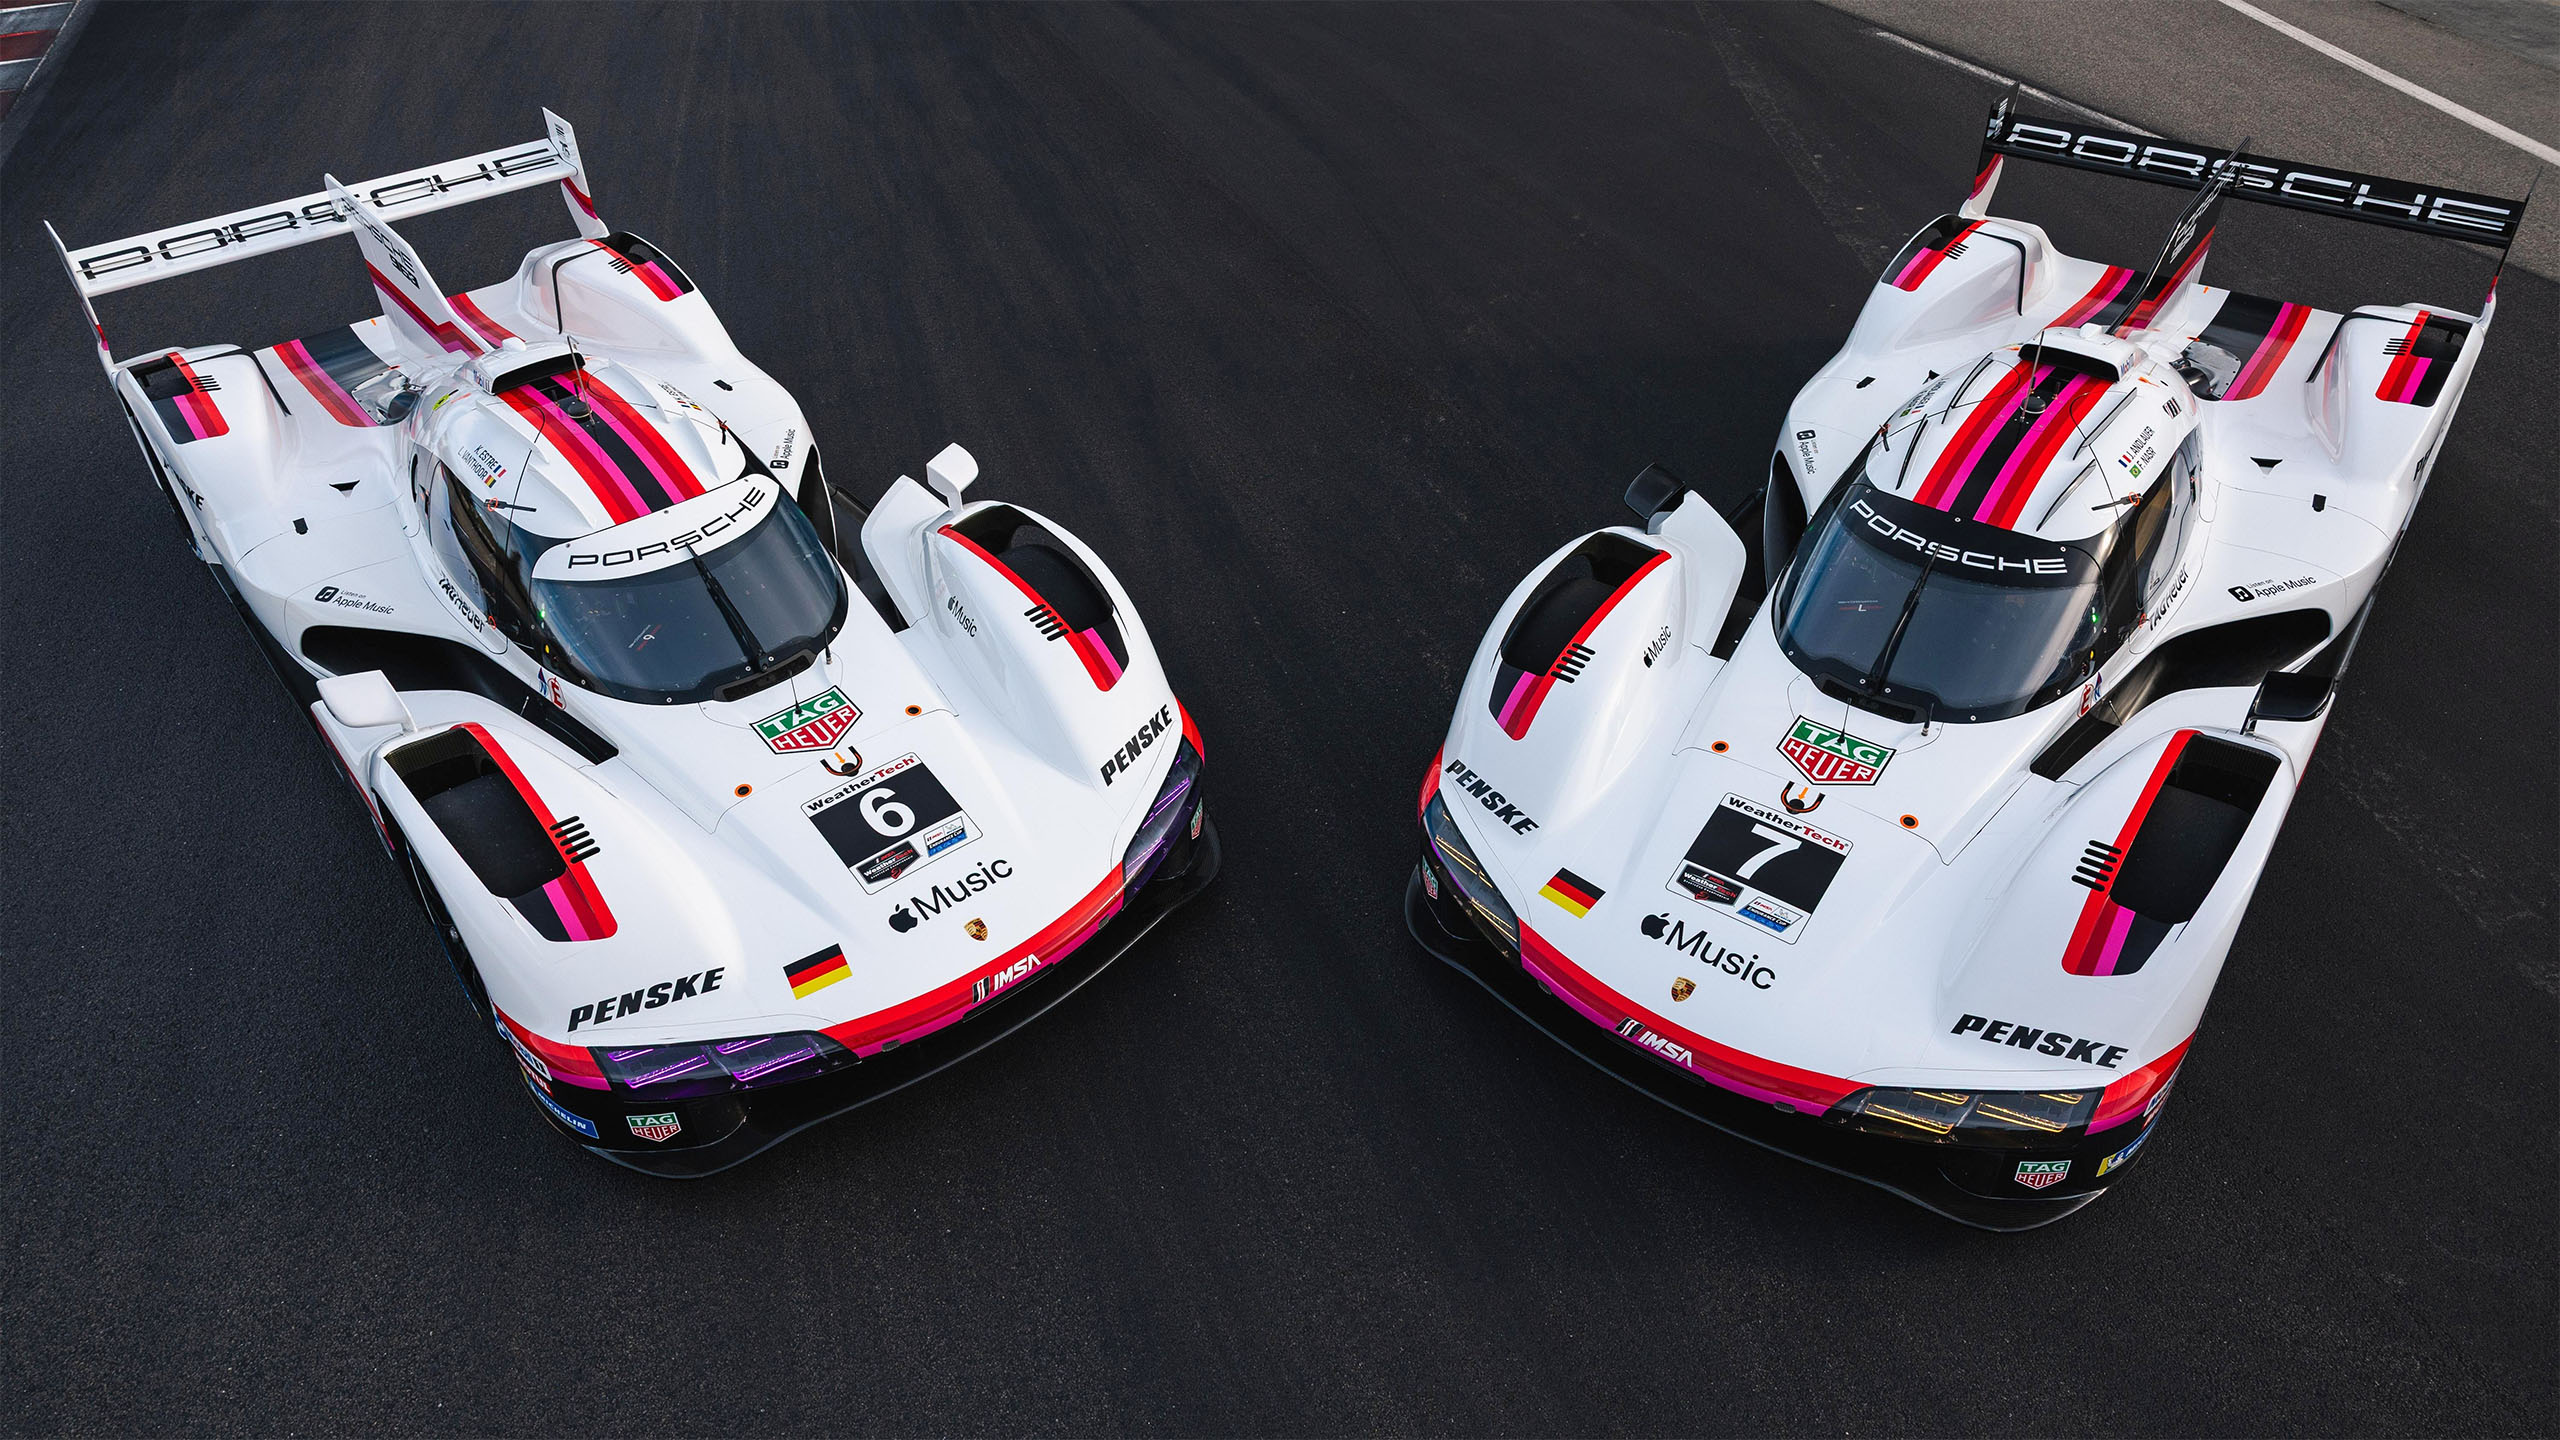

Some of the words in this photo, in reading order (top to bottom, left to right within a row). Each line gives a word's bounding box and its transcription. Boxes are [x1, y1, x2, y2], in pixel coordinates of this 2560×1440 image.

[2006, 122, 2511, 231] PORSCHE
[78, 147, 560, 281] PORSCHE
[460, 450, 489, 481] VANTHOOR
[478, 450, 499, 471] ESTRE
[1803, 457, 1817, 475] Music
[2142, 446, 2157, 467] NASR
[567, 486, 766, 569] PORSCHE
[1849, 499, 2068, 574] PORSCHE
[332, 596, 363, 608] Apple
[362, 601, 395, 615] Music
[2254, 584, 2286, 598] Apple
[2283, 575, 2317, 590] Music
[951, 599, 978, 638] Music
[1647, 625, 1672, 662] Music
[763, 695, 840, 732] TAG
[775, 707, 853, 749] HEUER
[1100, 704, 1172, 787] PENSKE
[1787, 740, 1873, 779] HEUER
[1804, 724, 1881, 764] TAG
[807, 755, 915, 812] WeatherTech
[1444, 758, 1540, 836] PENSKE
[859, 787, 916, 838] 6
[1729, 796, 1846, 851] WeatherTech
[1735, 822, 1803, 880] 7
[910, 859, 1013, 921] Music
[994, 953, 1042, 991] IMSA
[1665, 920, 1776, 990] Music
[567, 966, 725, 1033] PENSKE
[1638, 1031, 1693, 1068] IMSA
[1950, 1013, 2129, 1069] PENSKE
[538, 1091, 587, 1130] MICHELIN
[631, 1114, 673, 1127] TAG
[634, 1125, 678, 1140] HEUER
[2019, 1172, 2064, 1187] HEUER
[2023, 1162, 2066, 1173] TAG
